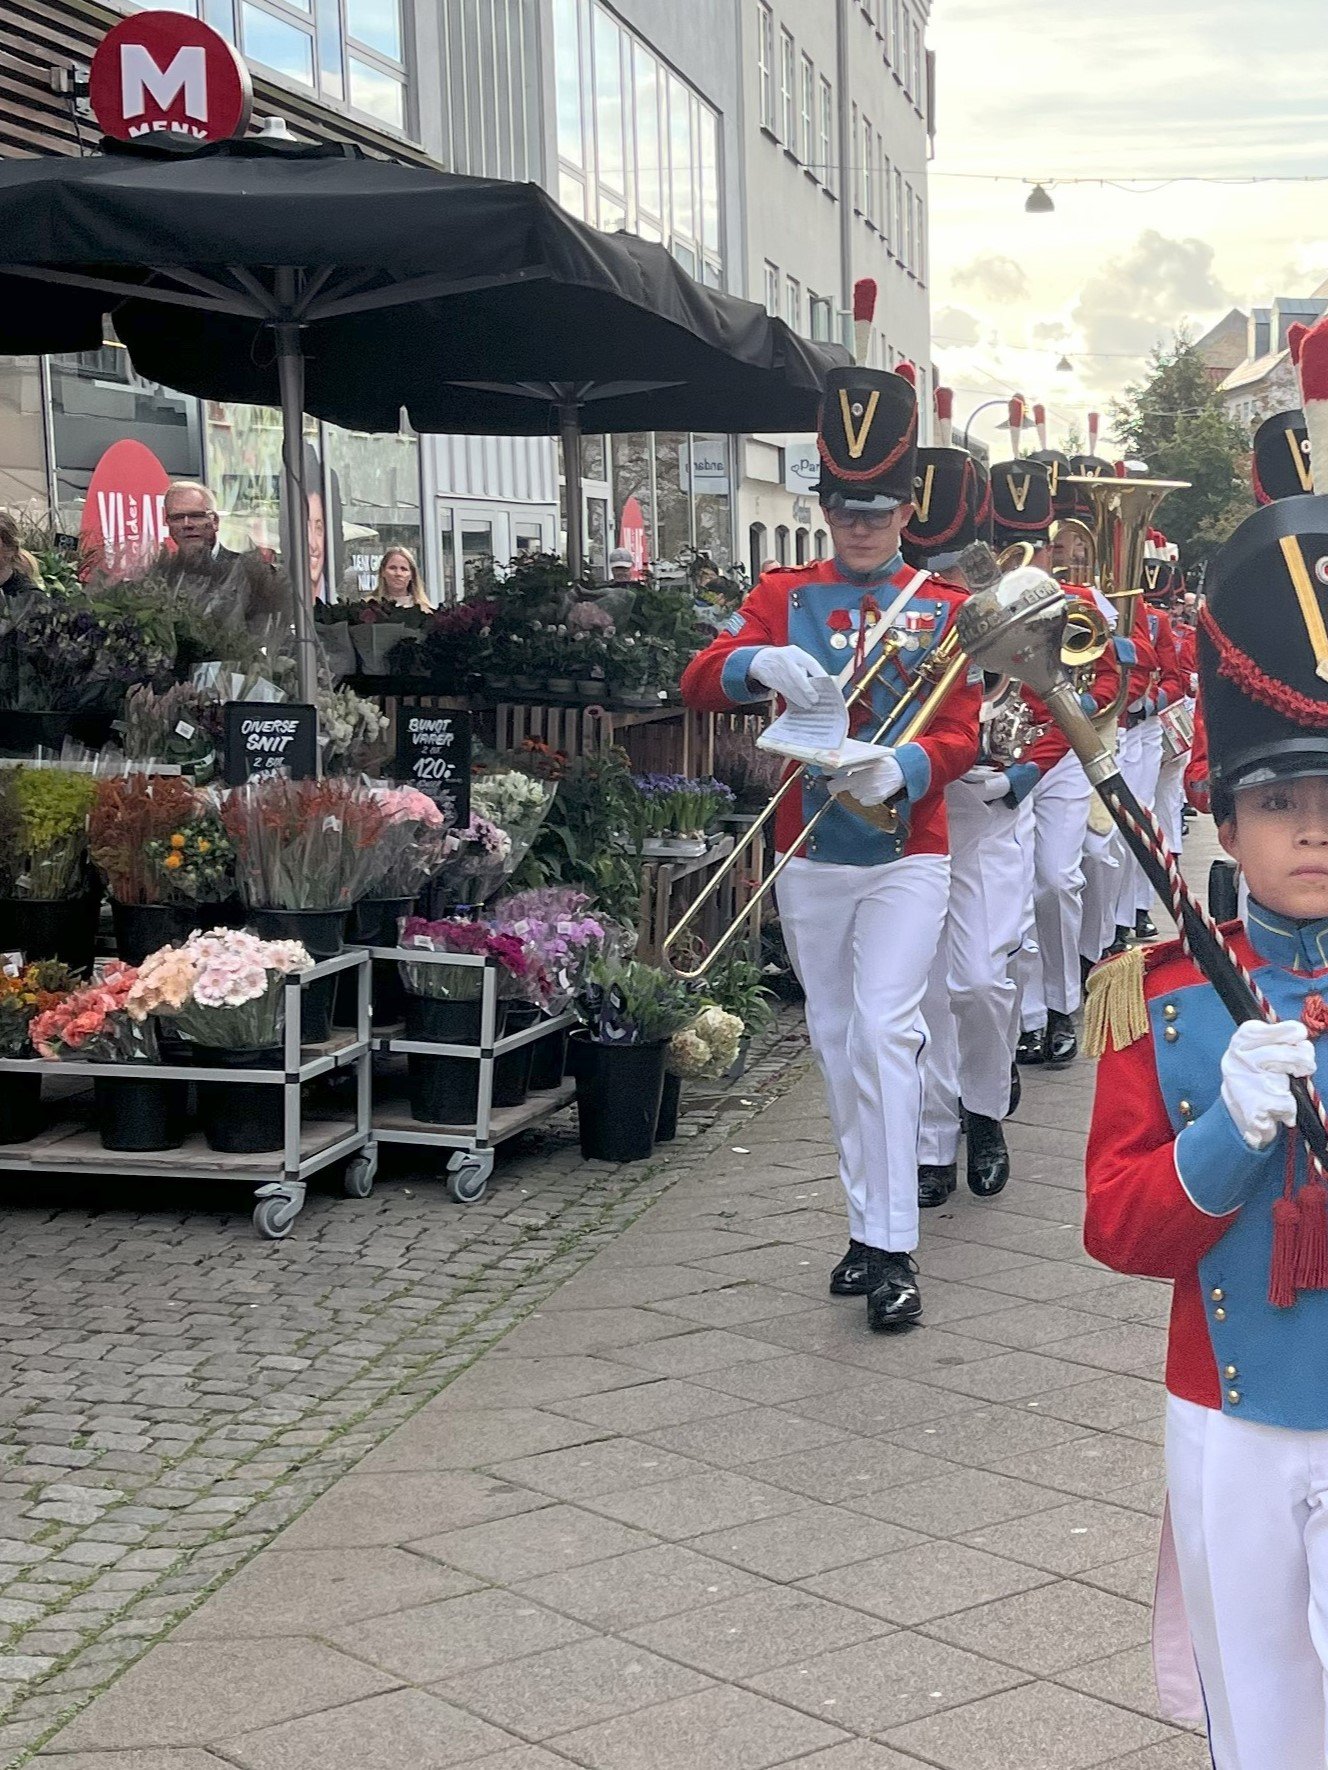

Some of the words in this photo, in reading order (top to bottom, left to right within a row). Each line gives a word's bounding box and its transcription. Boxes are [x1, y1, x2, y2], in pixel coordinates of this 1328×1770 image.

[120, 43, 208, 122] M
[246, 733, 294, 752] SNIT
[253, 757, 262, 767] 2
